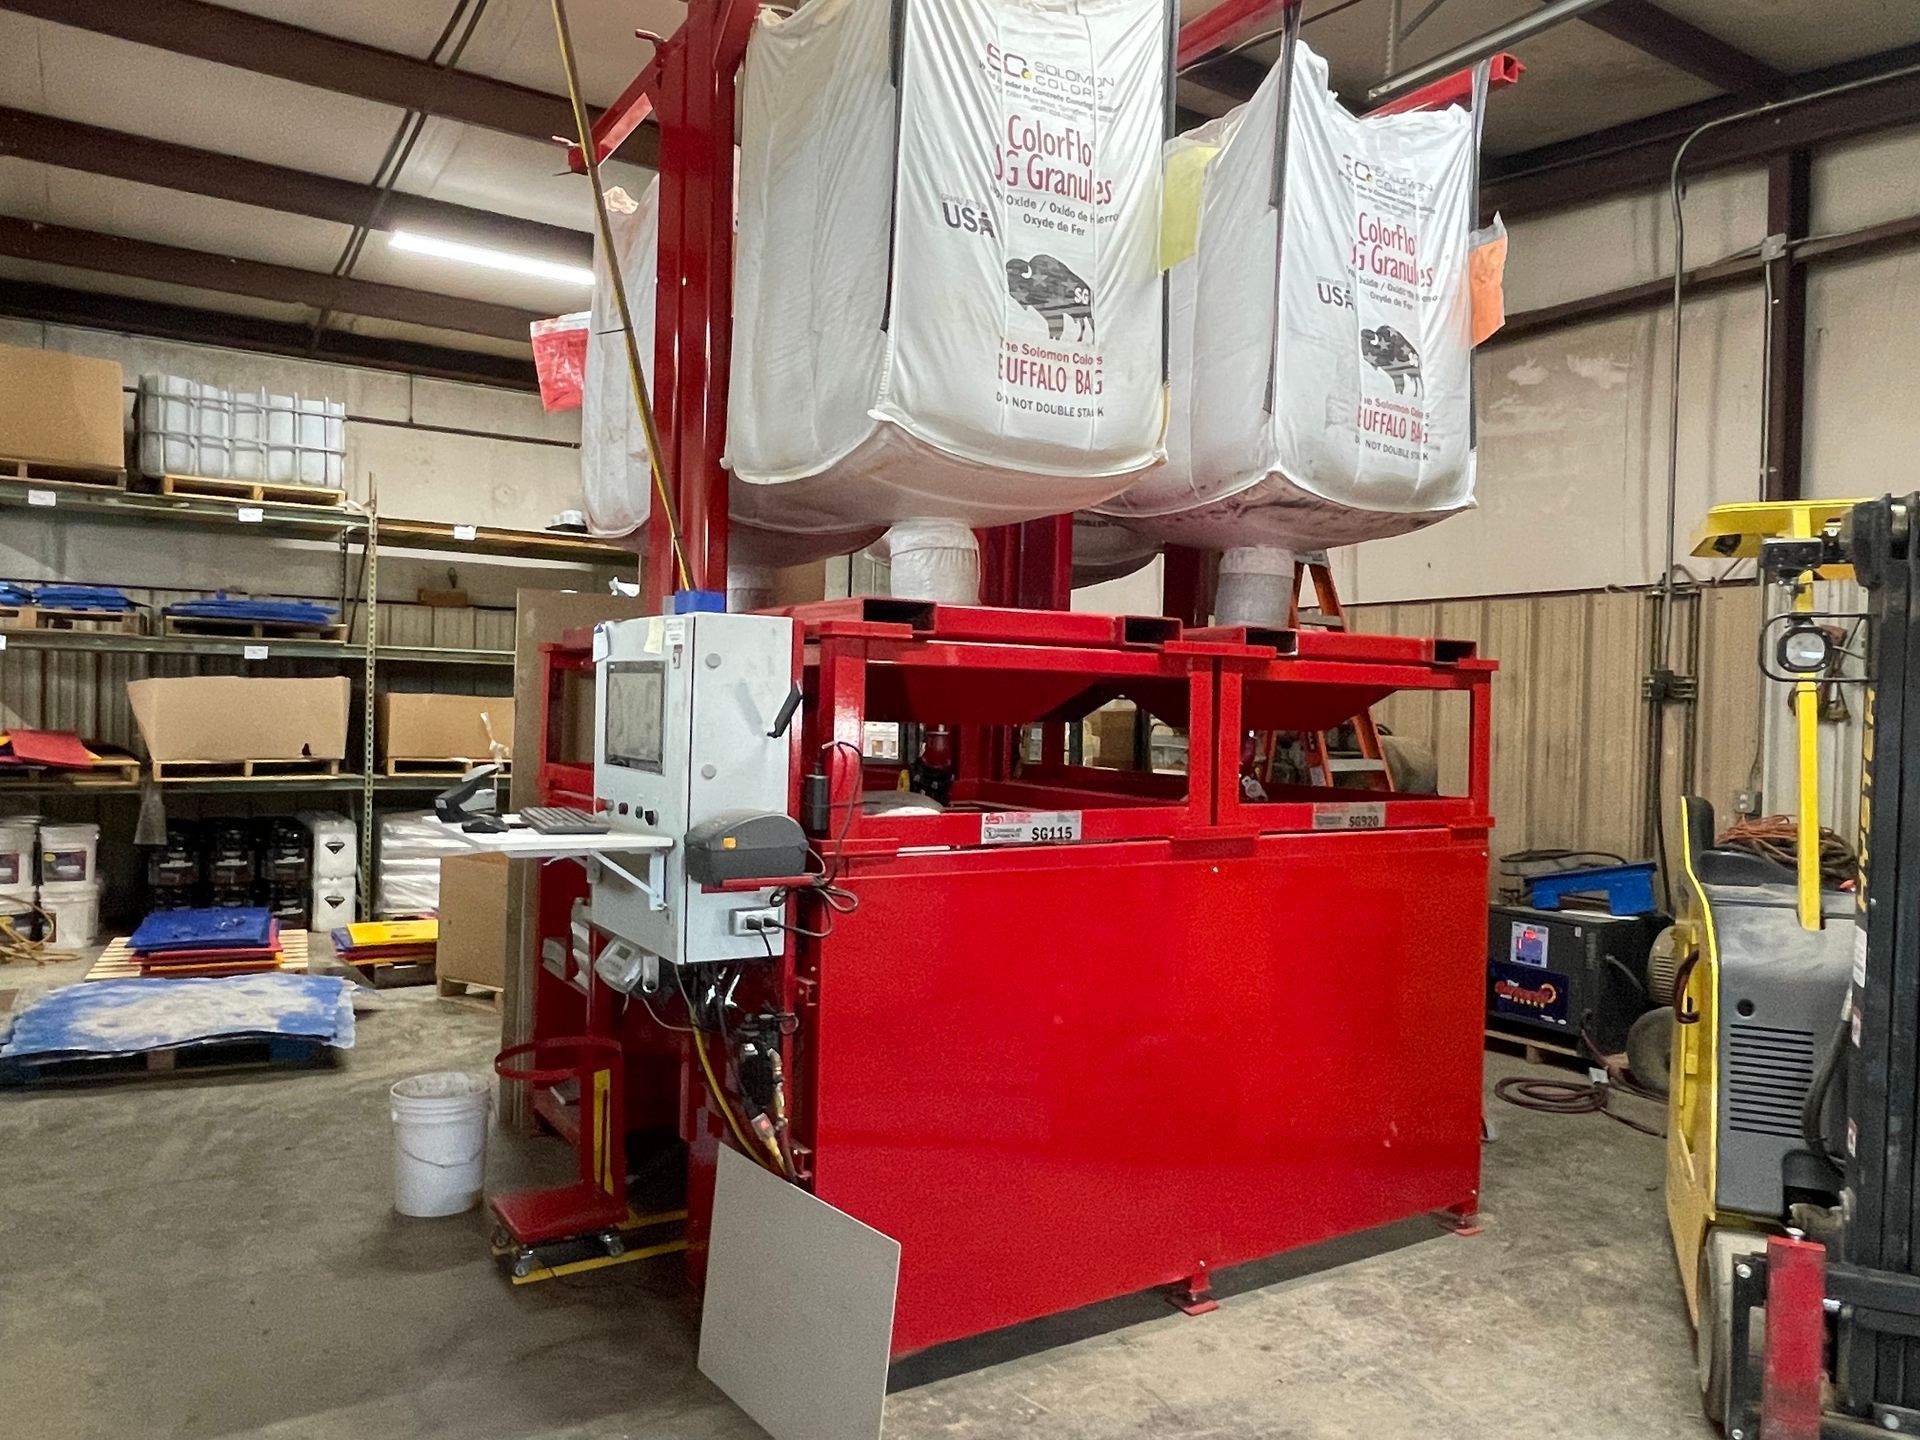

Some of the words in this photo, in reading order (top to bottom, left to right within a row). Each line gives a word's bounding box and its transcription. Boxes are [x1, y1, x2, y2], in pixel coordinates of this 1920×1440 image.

[1034, 61, 1115, 88] SOLOMON
[1035, 75, 1104, 101] COLORS
[1027, 153, 1112, 205] Granules
[1006, 194, 1037, 209] Oxide
[1049, 202, 1076, 218] Oxido
[1077, 211, 1088, 223] de
[942, 202, 996, 240] USA
[1023, 213, 1055, 229] Oxyde
[1057, 220, 1069, 232] de
[1071, 223, 1085, 236] Fer
[1022, 343, 1070, 364] Solomon
[1072, 353, 1103, 366] Colos
[1012, 396, 1033, 410] NOT
[1036, 400, 1075, 417] DOUBLE
[1365, 440, 1381, 451] NOT
[1349, 815, 1379, 828] SG920
[1031, 826, 1073, 841] SG115
